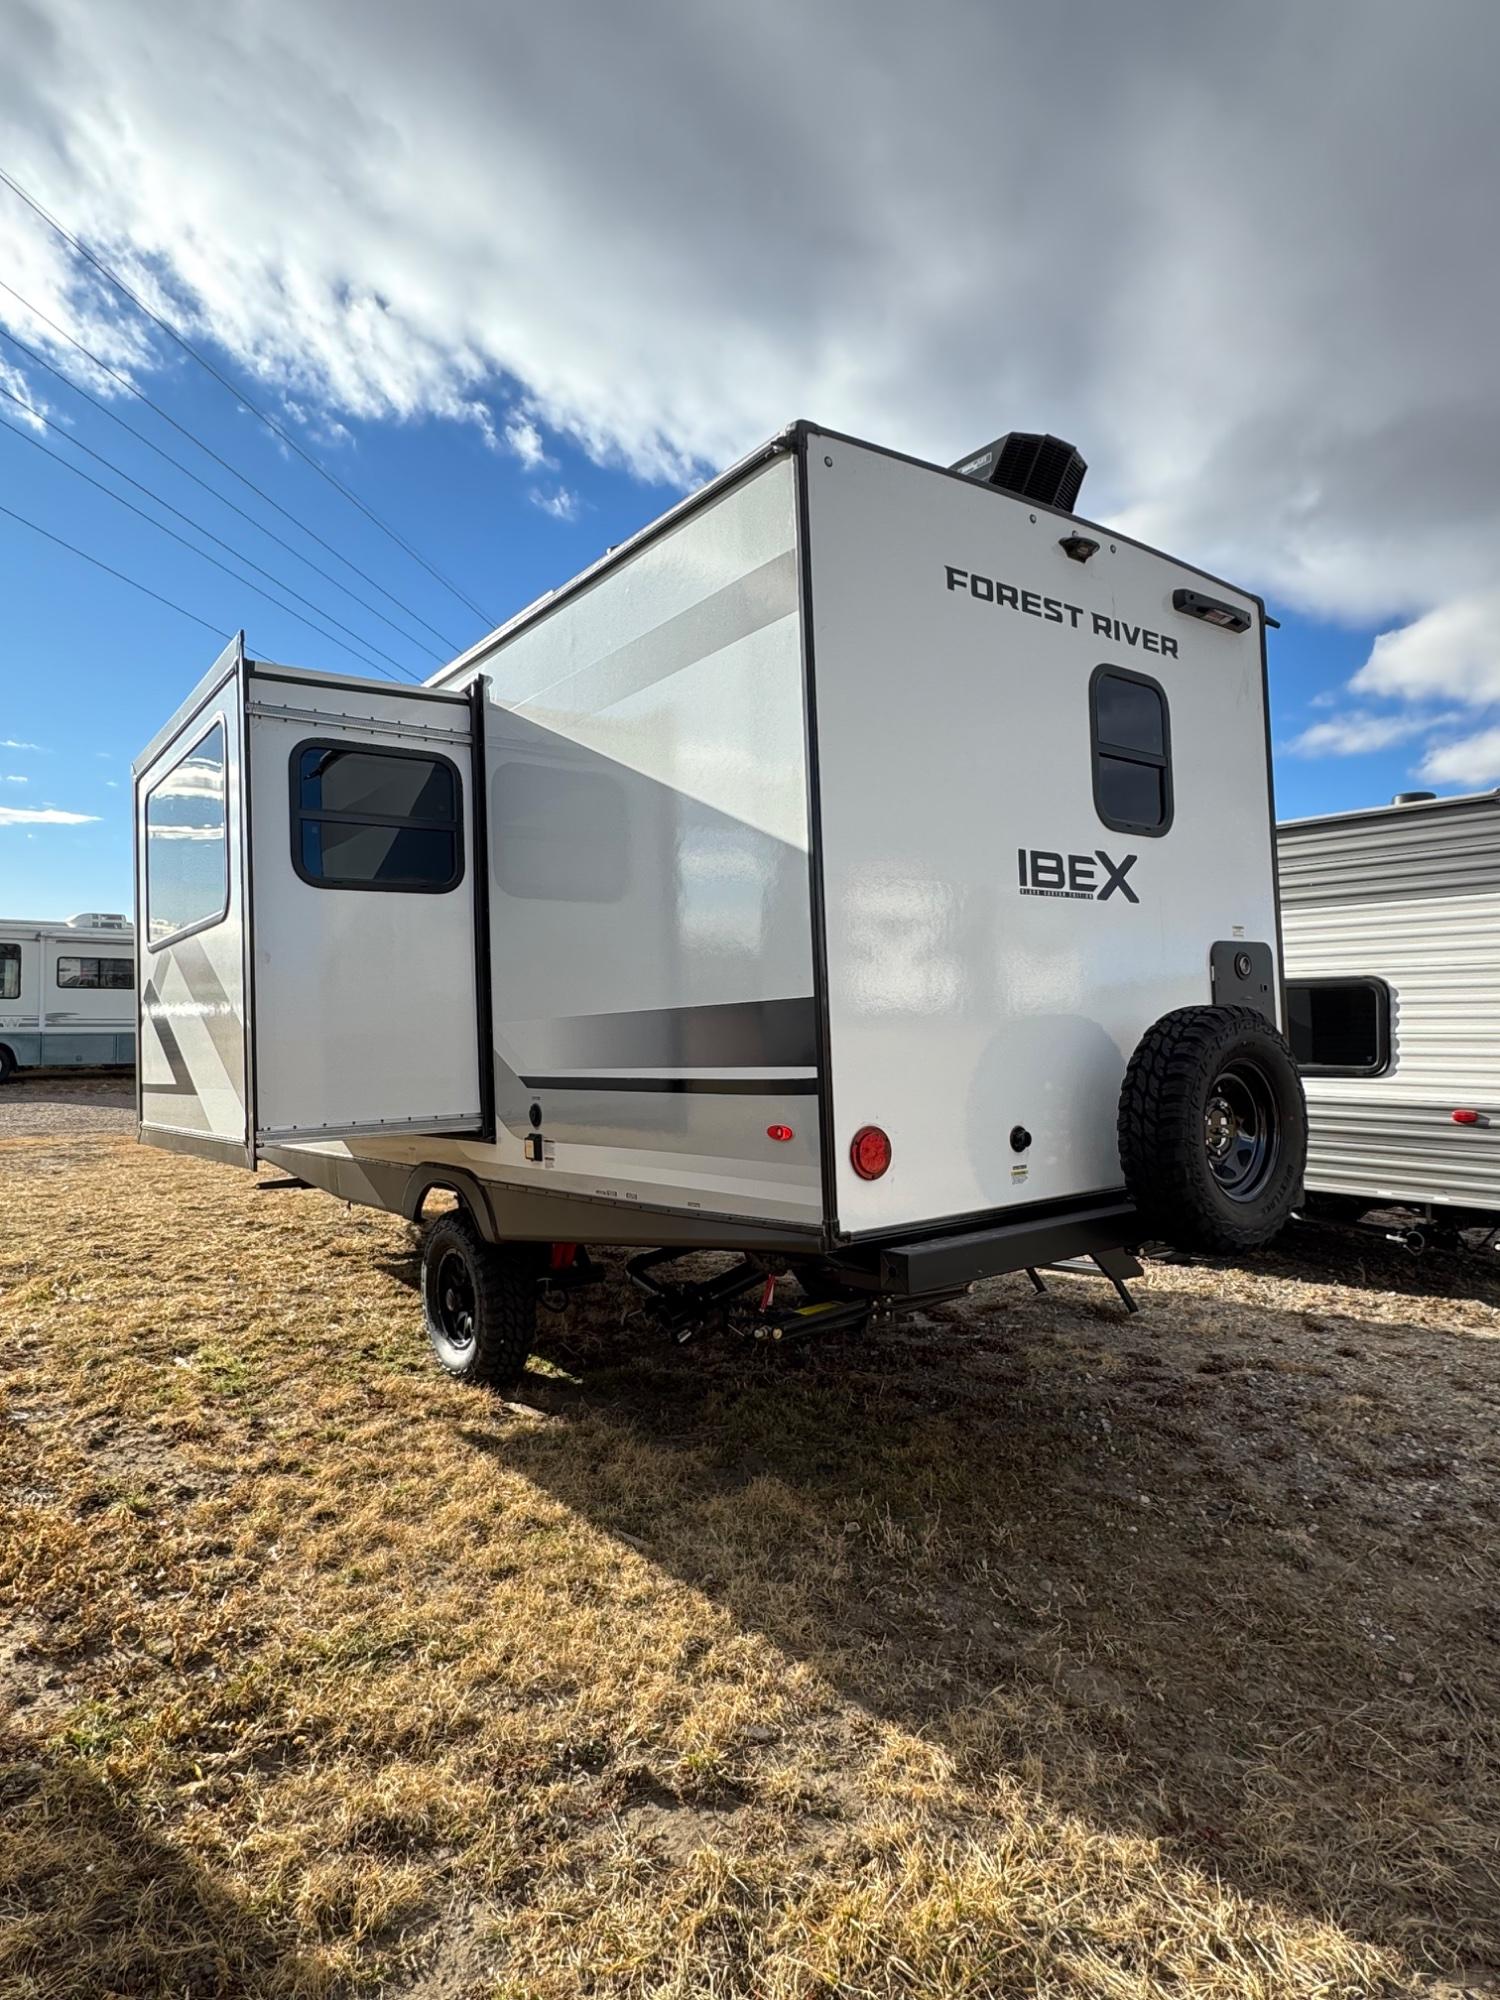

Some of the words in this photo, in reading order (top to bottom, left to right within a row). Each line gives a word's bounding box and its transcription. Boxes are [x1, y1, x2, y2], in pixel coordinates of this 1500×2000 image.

[944, 565, 1083, 628] FOREST
[1090, 611, 1179, 659] RIVER
[1018, 848, 1140, 904] IBEX
